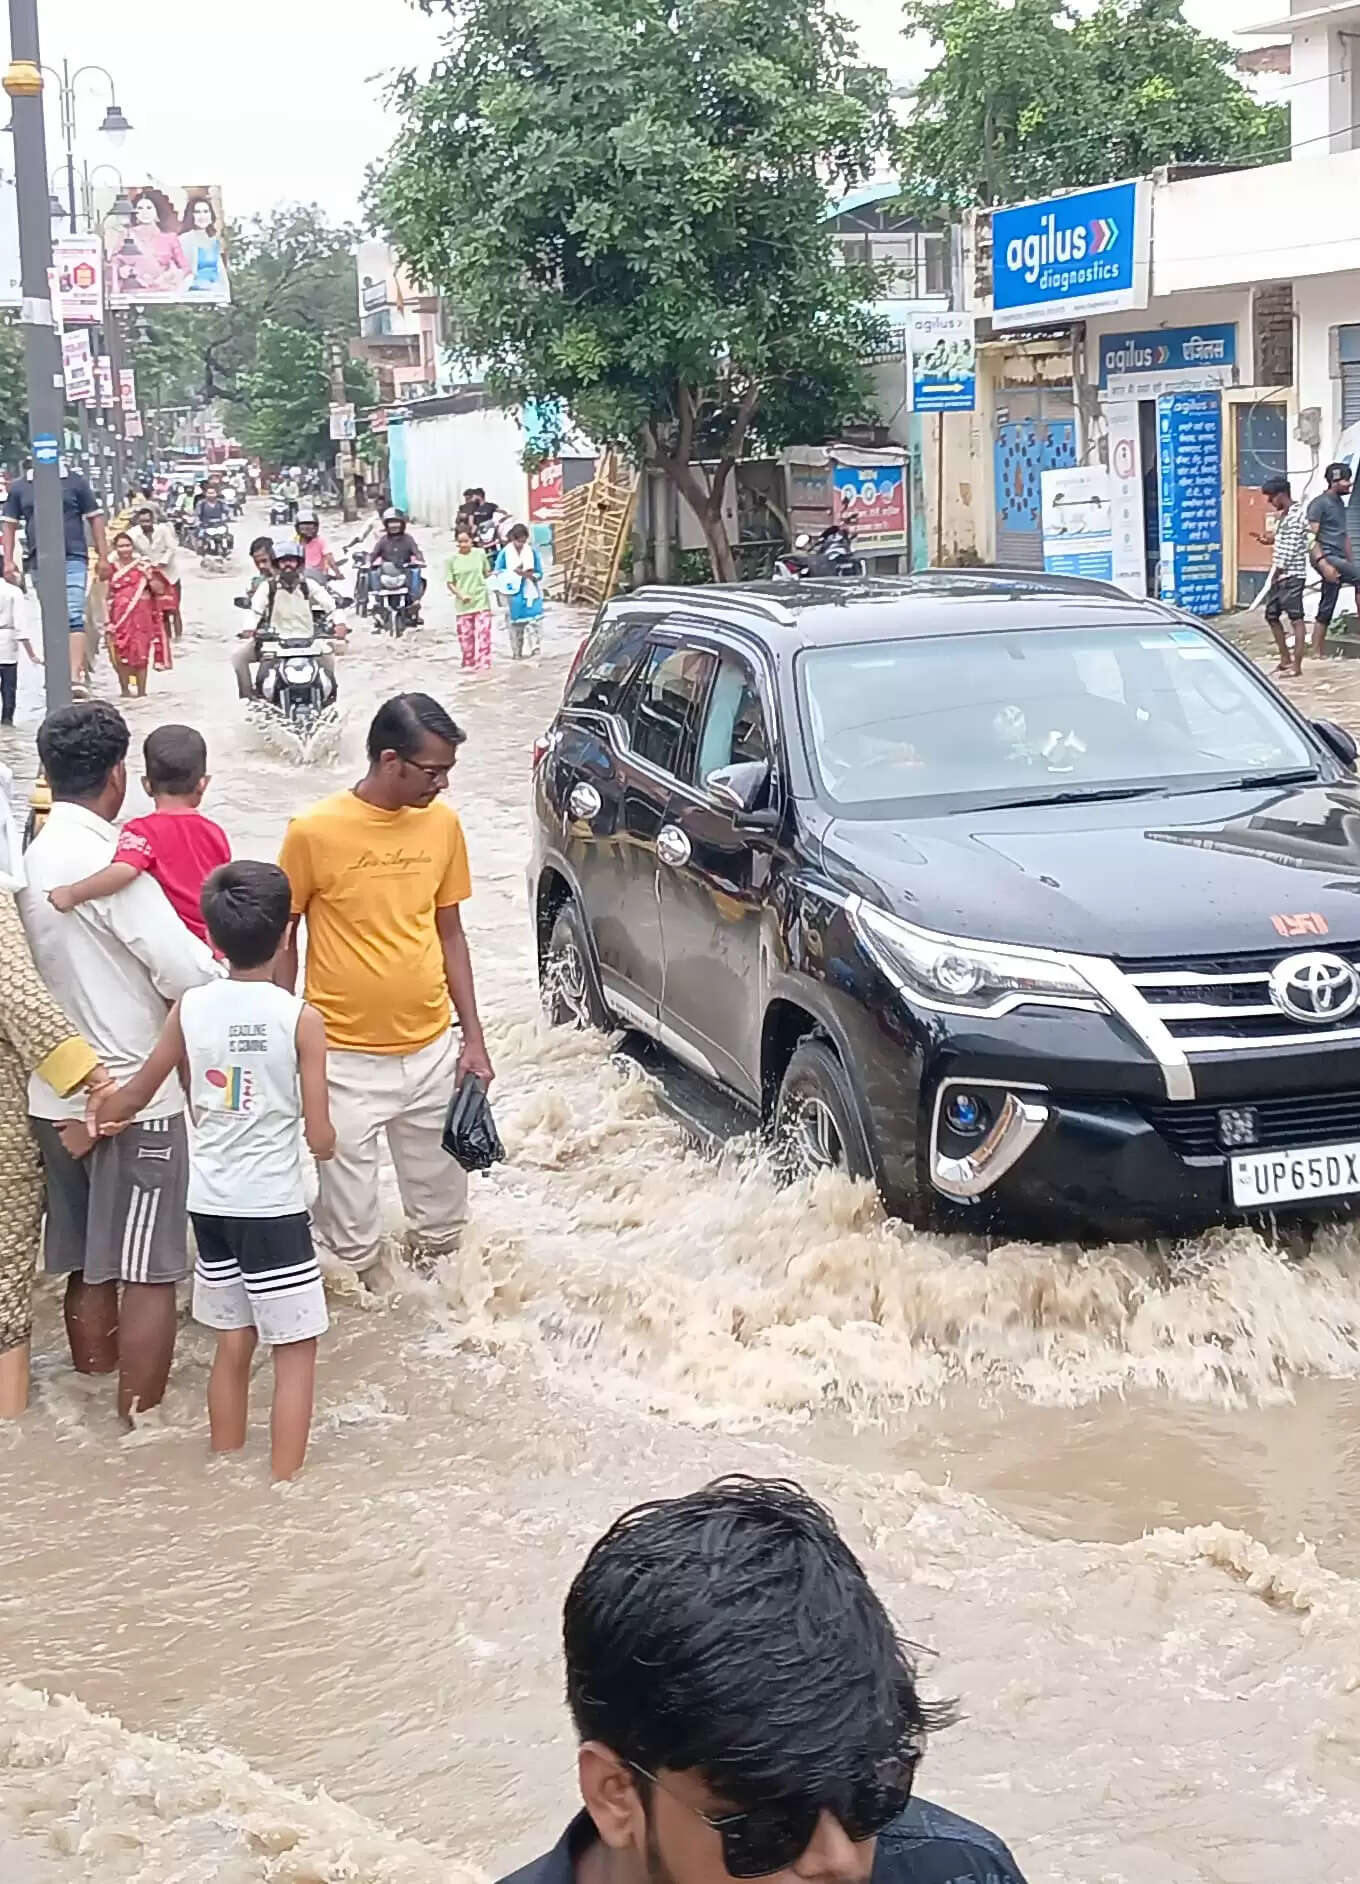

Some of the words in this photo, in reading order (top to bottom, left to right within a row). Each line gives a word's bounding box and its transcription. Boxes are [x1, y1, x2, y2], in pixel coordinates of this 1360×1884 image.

[1007, 214, 1087, 283] agilus
[1040, 260, 1119, 291] diagnostics
[915, 317, 954, 333] agilus
[1106, 340, 1152, 373] agilus
